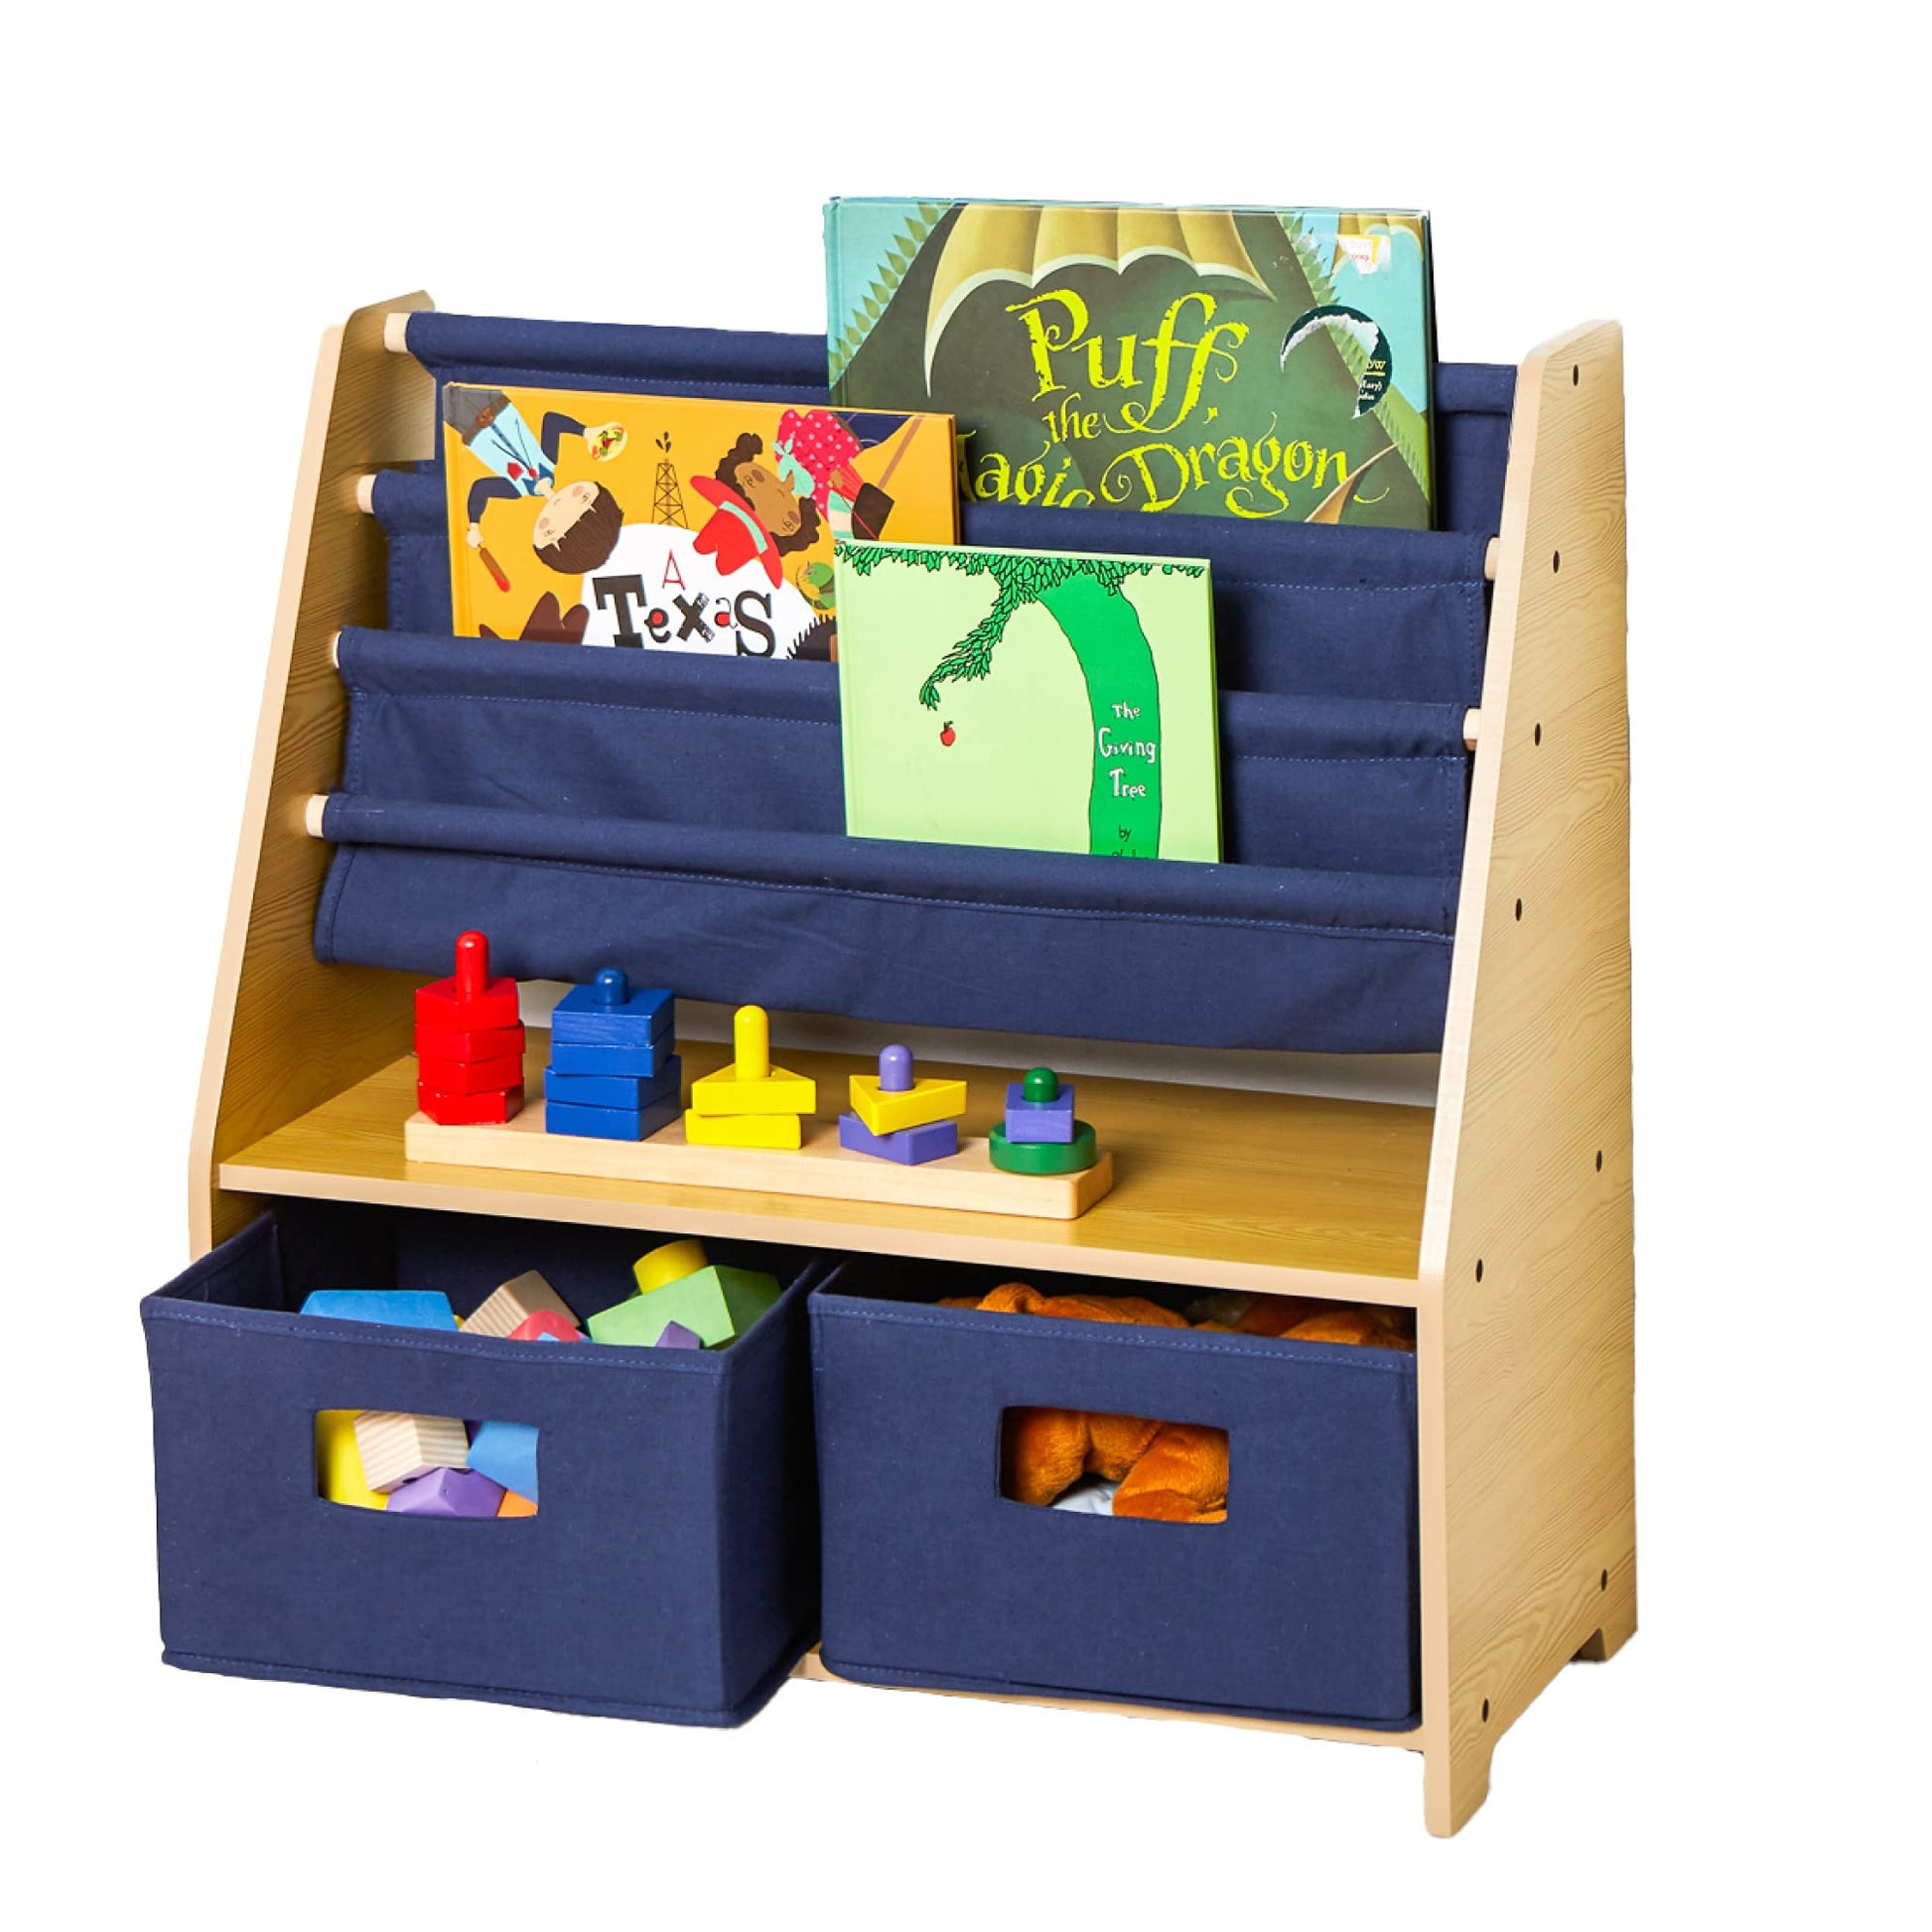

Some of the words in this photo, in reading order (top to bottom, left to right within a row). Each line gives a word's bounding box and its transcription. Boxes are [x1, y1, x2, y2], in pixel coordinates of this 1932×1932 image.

[1042, 392, 1102, 445] the
[1099, 410, 1391, 520] Dragon
[661, 548, 687, 592] A
[1111, 701, 1142, 719] The
[1098, 727, 1157, 764] Giving
[1109, 767, 1147, 799] Tree
[1118, 824, 1133, 843] by
